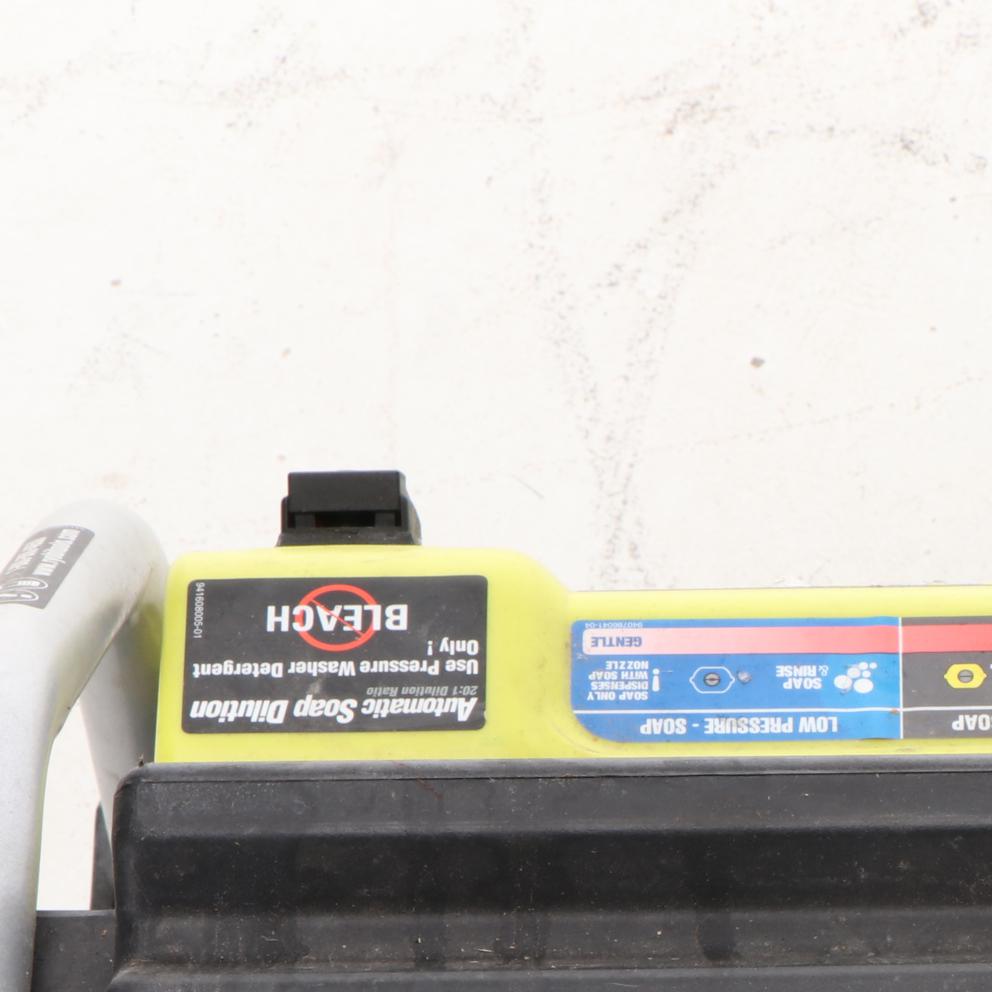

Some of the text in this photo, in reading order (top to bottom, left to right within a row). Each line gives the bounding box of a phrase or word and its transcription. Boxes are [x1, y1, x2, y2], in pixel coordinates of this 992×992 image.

[193, 582, 205, 638] 941608005-01
[266, 604, 408, 632] BLEACH
[591, 636, 642, 647] GENTLE
[193, 659, 478, 678] Use Pressure Washer Detergent
[605, 660, 648, 670] NOZZLE
[588, 671, 648, 680] WITH SOAP
[367, 686, 478, 696] 20:1 Dilution Ratio
[590, 681, 648, 690] DISPENSES
[782, 678, 822, 690] SOAP
[587, 692, 648, 700] SOAP ONLY
[190, 695, 478, 724] Automatic Soap Dilution
[640, 718, 687, 734] SOAP
[704, 716, 793, 734] PRESSURE
[799, 716, 838, 733] LOW
